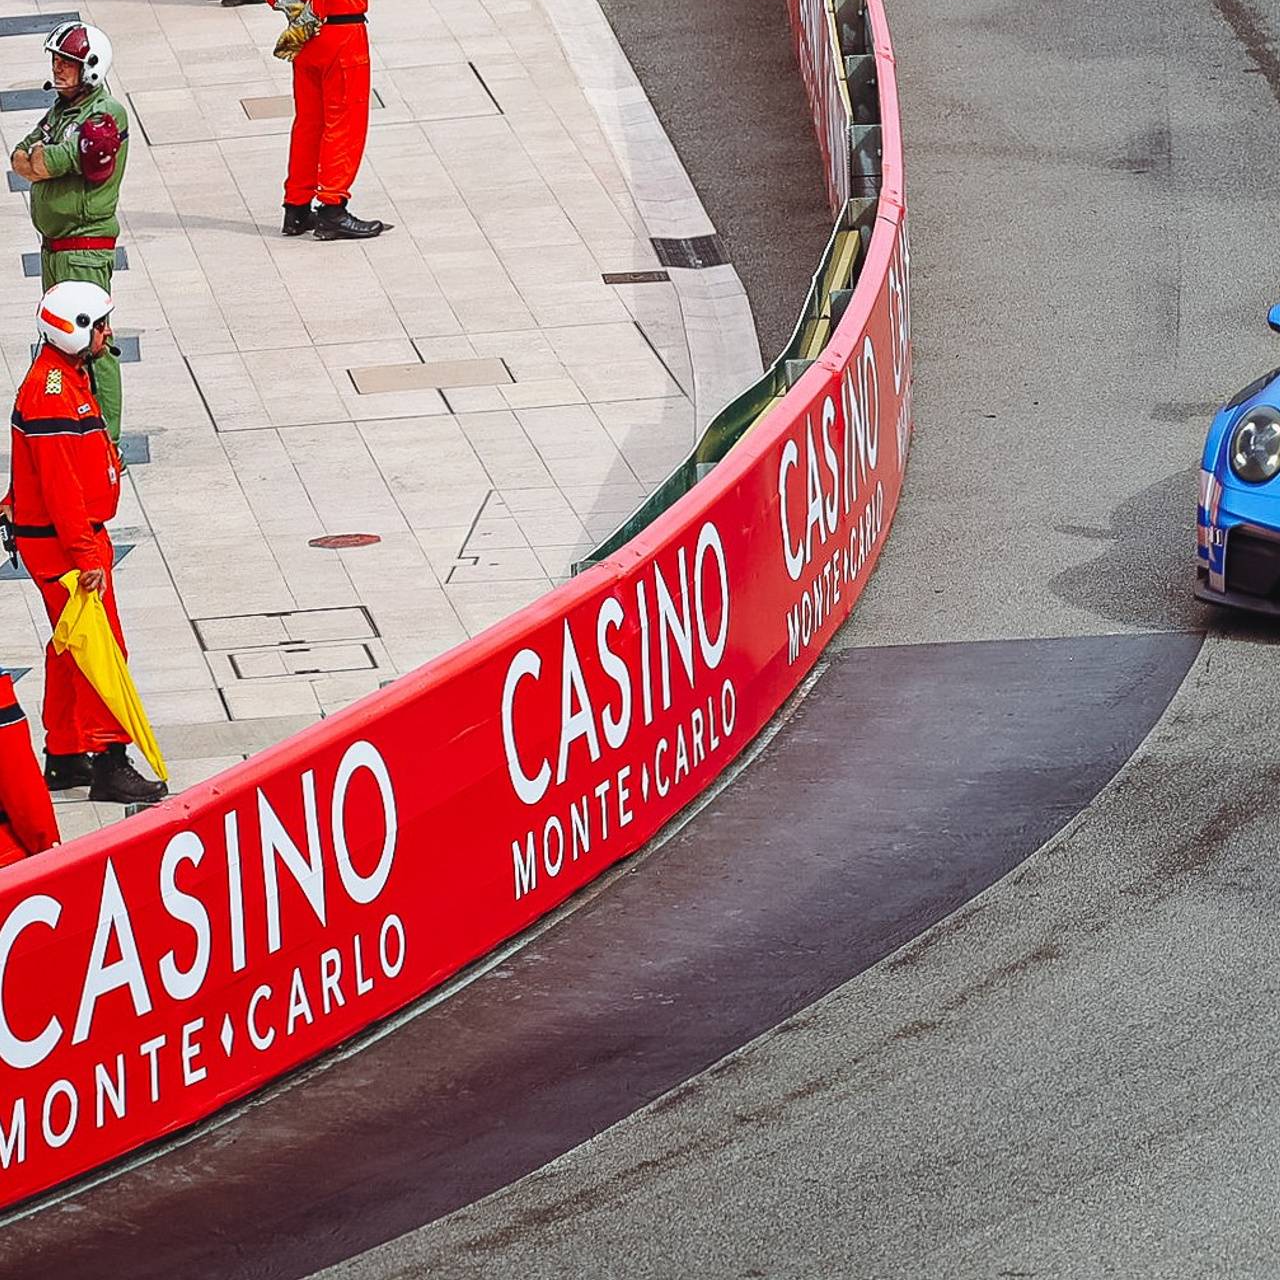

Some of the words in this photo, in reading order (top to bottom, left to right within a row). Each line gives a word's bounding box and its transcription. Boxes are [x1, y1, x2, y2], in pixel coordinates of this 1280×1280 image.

[778, 335, 880, 582] CASINO
[501, 522, 730, 805] CASINO
[0, 740, 398, 1069] CASINO
